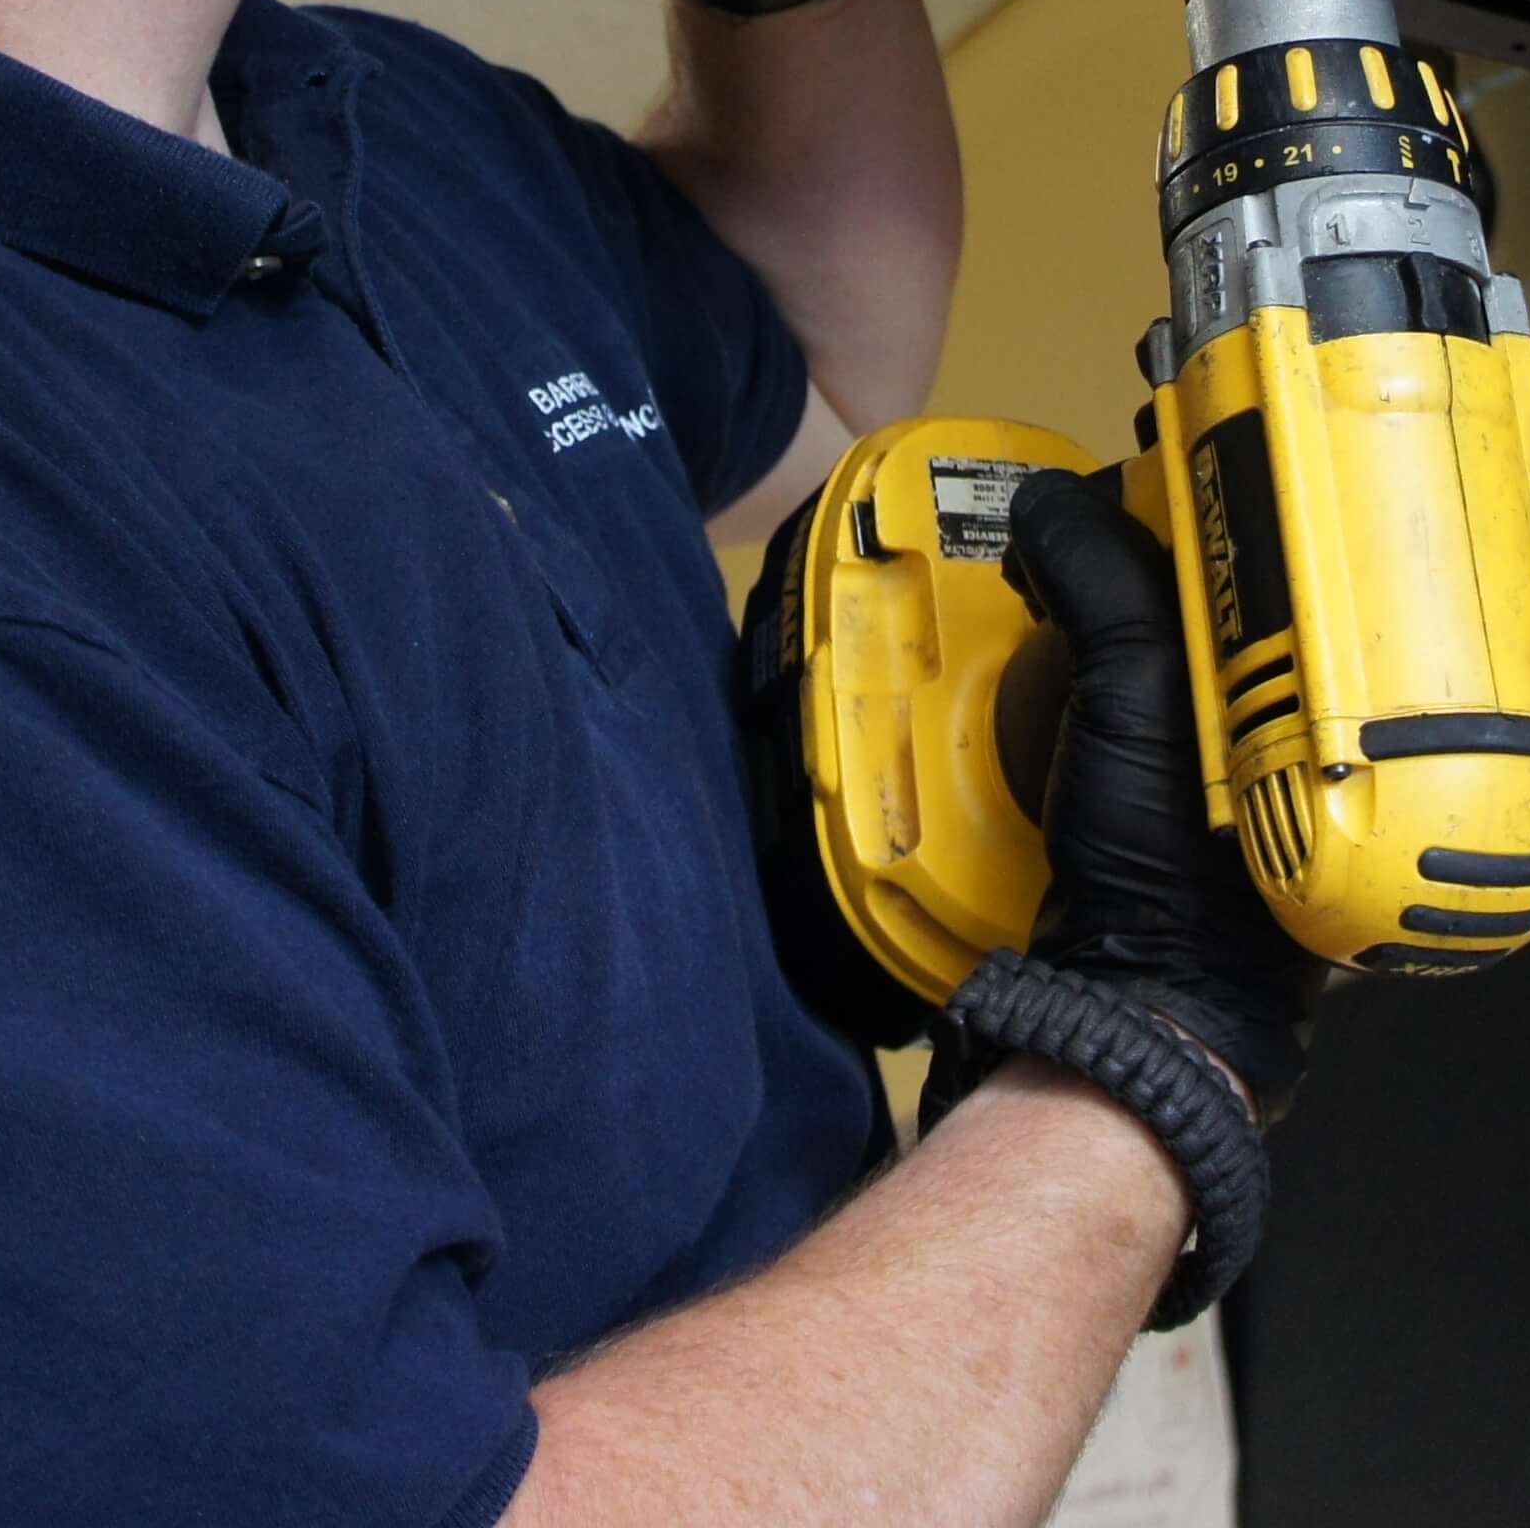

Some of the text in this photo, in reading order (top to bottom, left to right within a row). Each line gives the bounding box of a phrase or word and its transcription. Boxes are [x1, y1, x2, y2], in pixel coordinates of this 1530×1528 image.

[1212, 163, 1238, 186] 19
[1283, 143, 1313, 166] 21
[1326, 212, 1350, 246] 1
